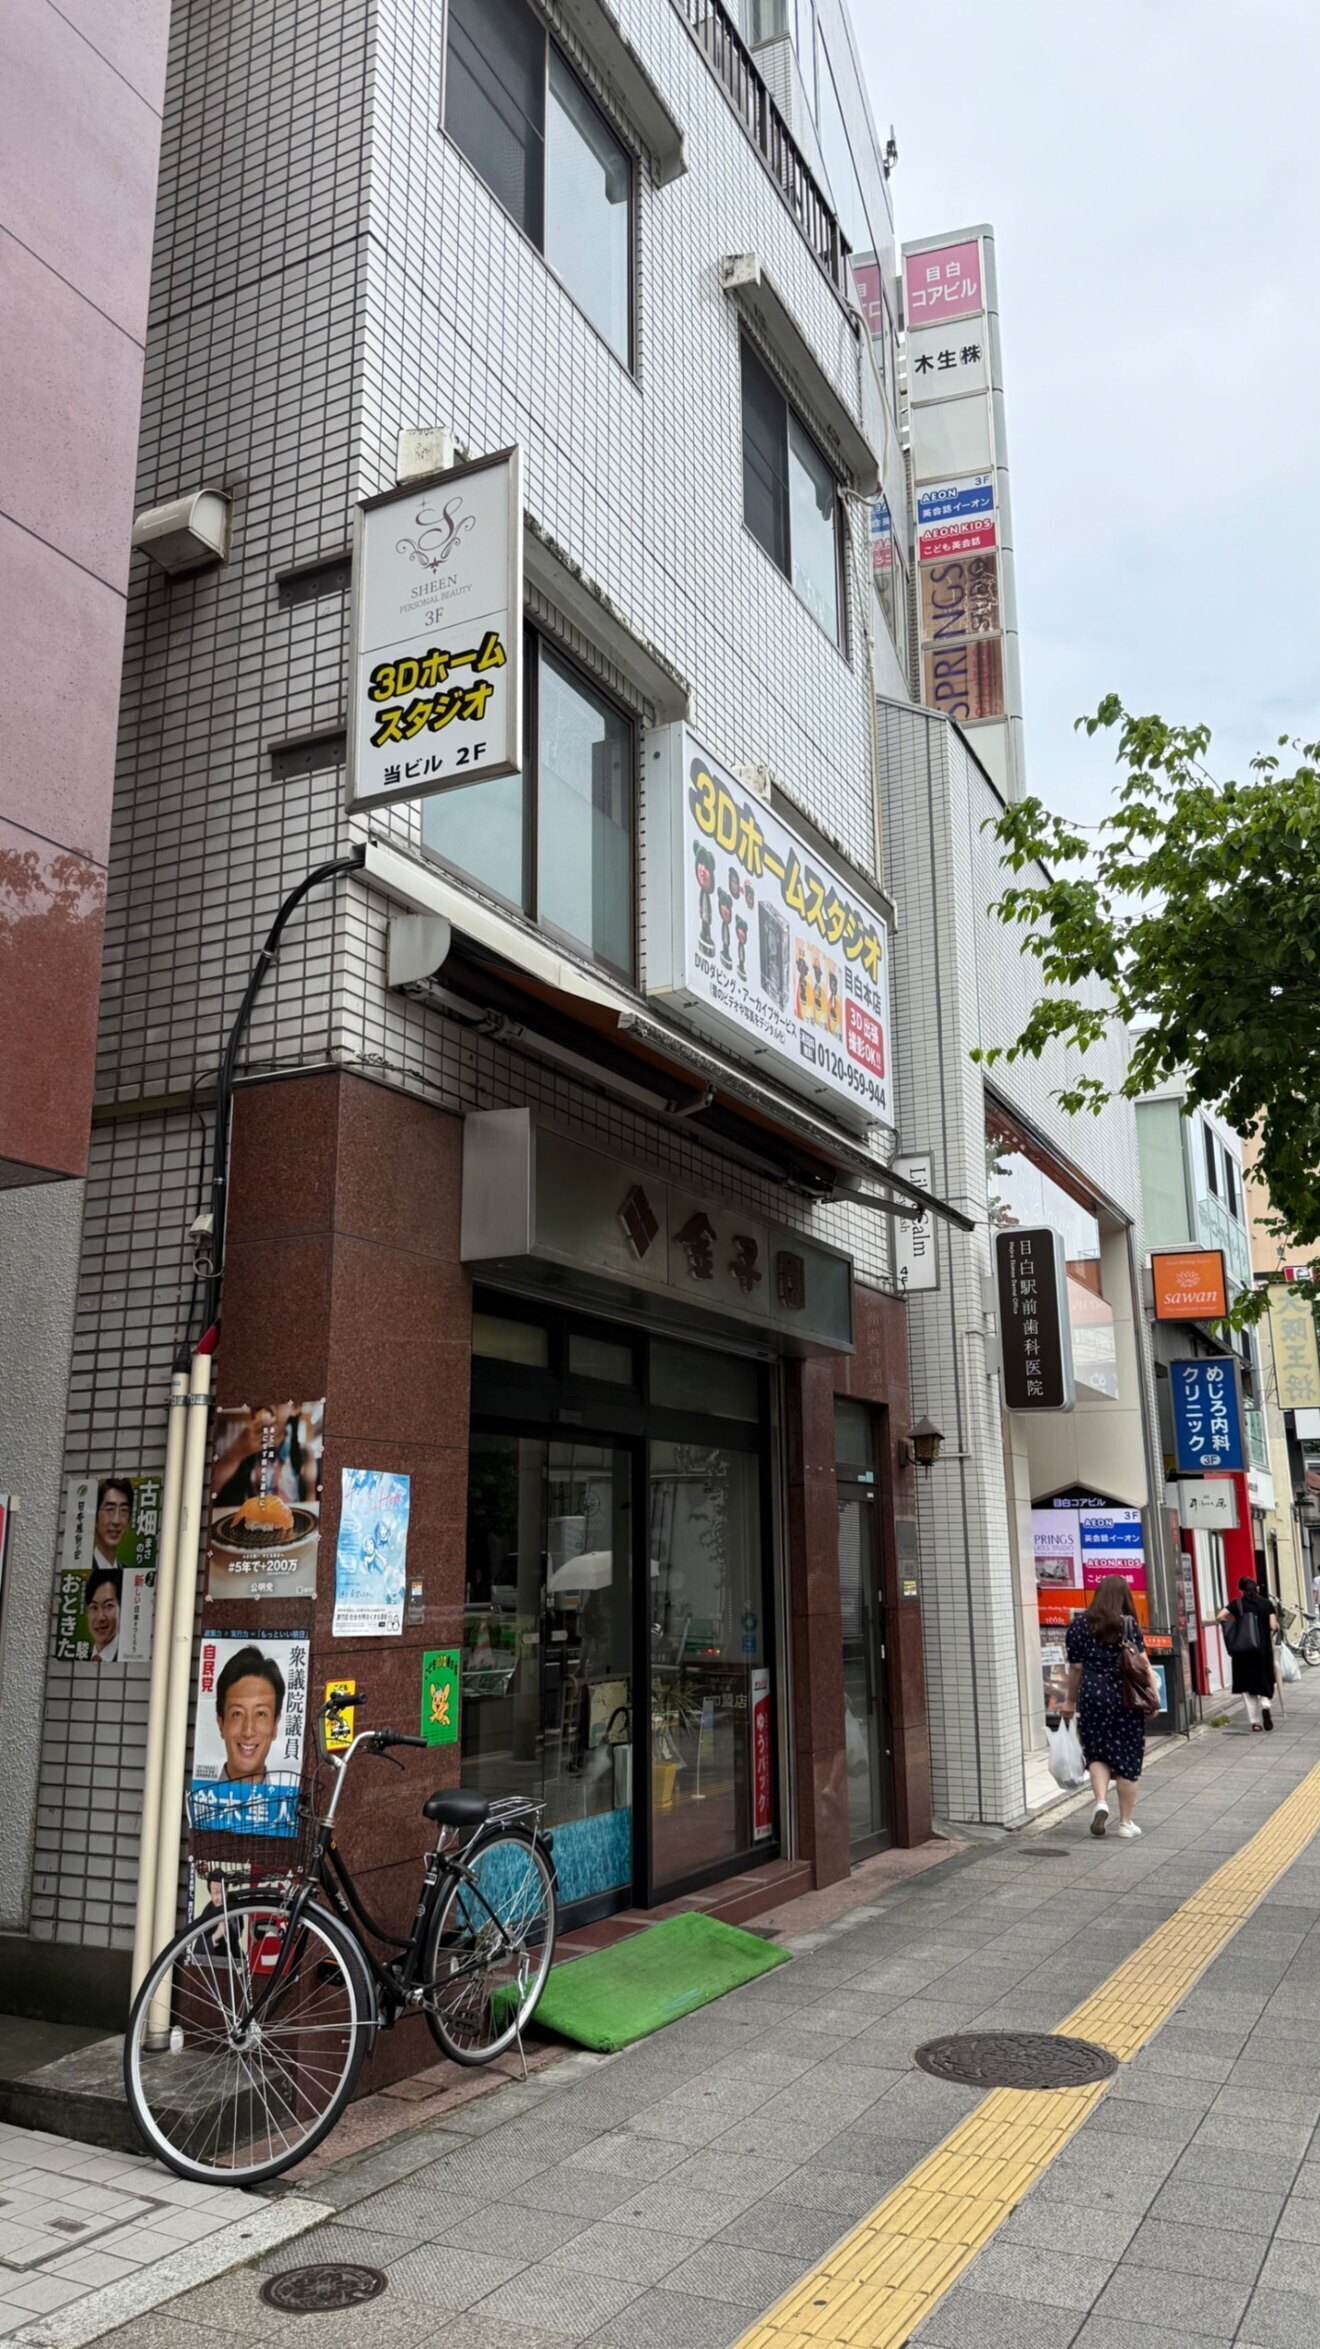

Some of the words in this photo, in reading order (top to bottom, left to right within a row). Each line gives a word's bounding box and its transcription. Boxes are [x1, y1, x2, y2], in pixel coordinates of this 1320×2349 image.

[926, 261, 961, 283] 目白
[911, 278, 977, 308] コアビル
[974, 475, 990, 487] 3F
[921, 488, 959, 504] AEON
[922, 498, 991, 518] 英会話イーオン
[922, 523, 960, 541] AEON
[961, 518, 993, 535] KIDS
[924, 536, 981, 555] こども英会話
[400, 594, 440, 614] PERSONAL
[441, 583, 473, 600] BEAUTY
[411, 574, 458, 599] SHEEN
[424, 607, 444, 627] 3F
[369, 632, 507, 702] 3Dホーム
[371, 679, 495, 749] スタジオ
[383, 754, 443, 786] 当ビル
[456, 742, 487, 766] 2F
[691, 758, 882, 984] 3Dホームスタジオ
[844, 965, 882, 1017] 目白本店
[817, 1042, 886, 1111] 0120-959-944
[1163, 1291, 1217, 1305] sawan
[1020, 1240, 1044, 1397] 目白駅前歯科医院
[1182, 1366, 1205, 1452] クリニック
[1206, 1366, 1230, 1451] めじろ内科
[1203, 1455, 1218, 1466] 3F
[136, 1480, 160, 1536] 古畑
[1053, 1498, 1106, 1507] 目白コアビル
[1124, 1511, 1139, 1520] 3F
[1083, 1518, 1114, 1528] AEON
[1034, 1534, 1074, 1545] PRINGS
[1084, 1534, 1140, 1543] 英会話イーオン
[1087, 1558, 1115, 1568] AEON
[1116, 1558, 1142, 1568] KIDS
[57, 1573, 82, 1658] おときた
[201, 1644, 216, 1693] 自民党
[284, 1645, 307, 1761] 衆議院議員
[756, 1711, 766, 1813] ゆうパック
